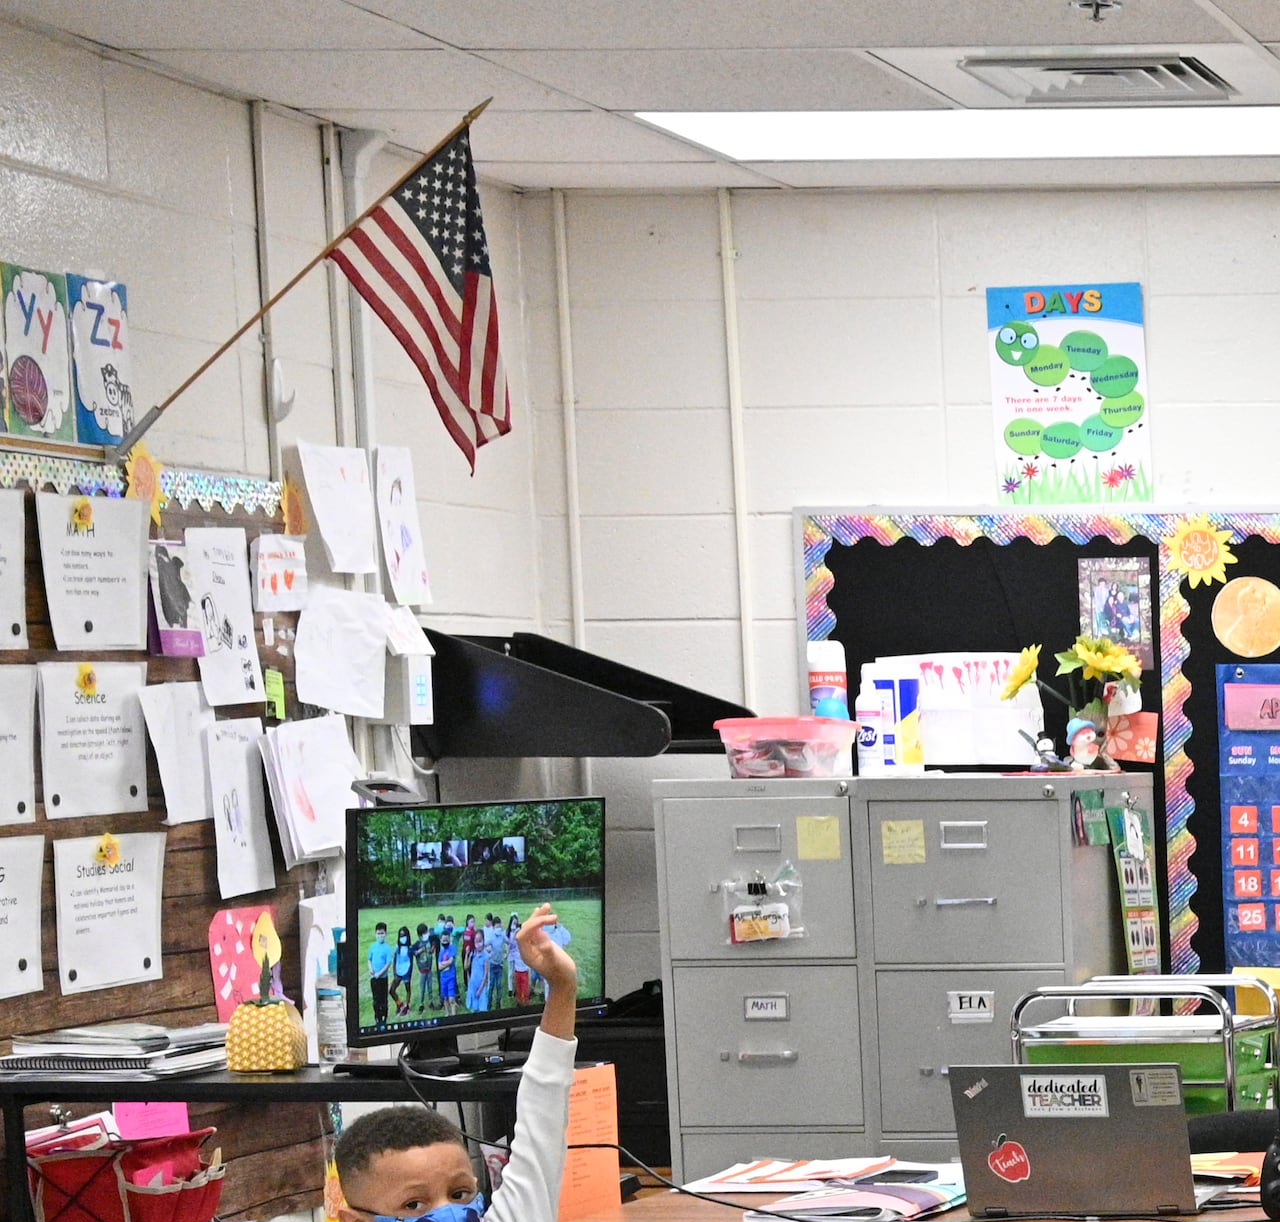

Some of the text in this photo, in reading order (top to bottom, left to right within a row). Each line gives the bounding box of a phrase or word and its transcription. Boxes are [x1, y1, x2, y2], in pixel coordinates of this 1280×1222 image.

[1024, 289, 1103, 314] DAYS
[16, 289, 53, 354] Yy
[85, 301, 123, 350] Zz
[1066, 345, 1102, 355] Tuesday
[1030, 361, 1063, 374] Monday
[1091, 370, 1139, 385] Wednesday
[1103, 403, 1142, 416] Thursday
[1009, 428, 1041, 438] Sunday
[1086, 428, 1114, 439] Friday
[1042, 434, 1080, 448] Saturday
[74, 691, 107, 705] Science
[1228, 755, 1257, 766] Sunday
[76, 864, 106, 879] Studies
[958, 995, 987, 1010] ELA
[1027, 1079, 1101, 1094] dedicated
[1027, 1093, 1103, 1107] TEACHER
